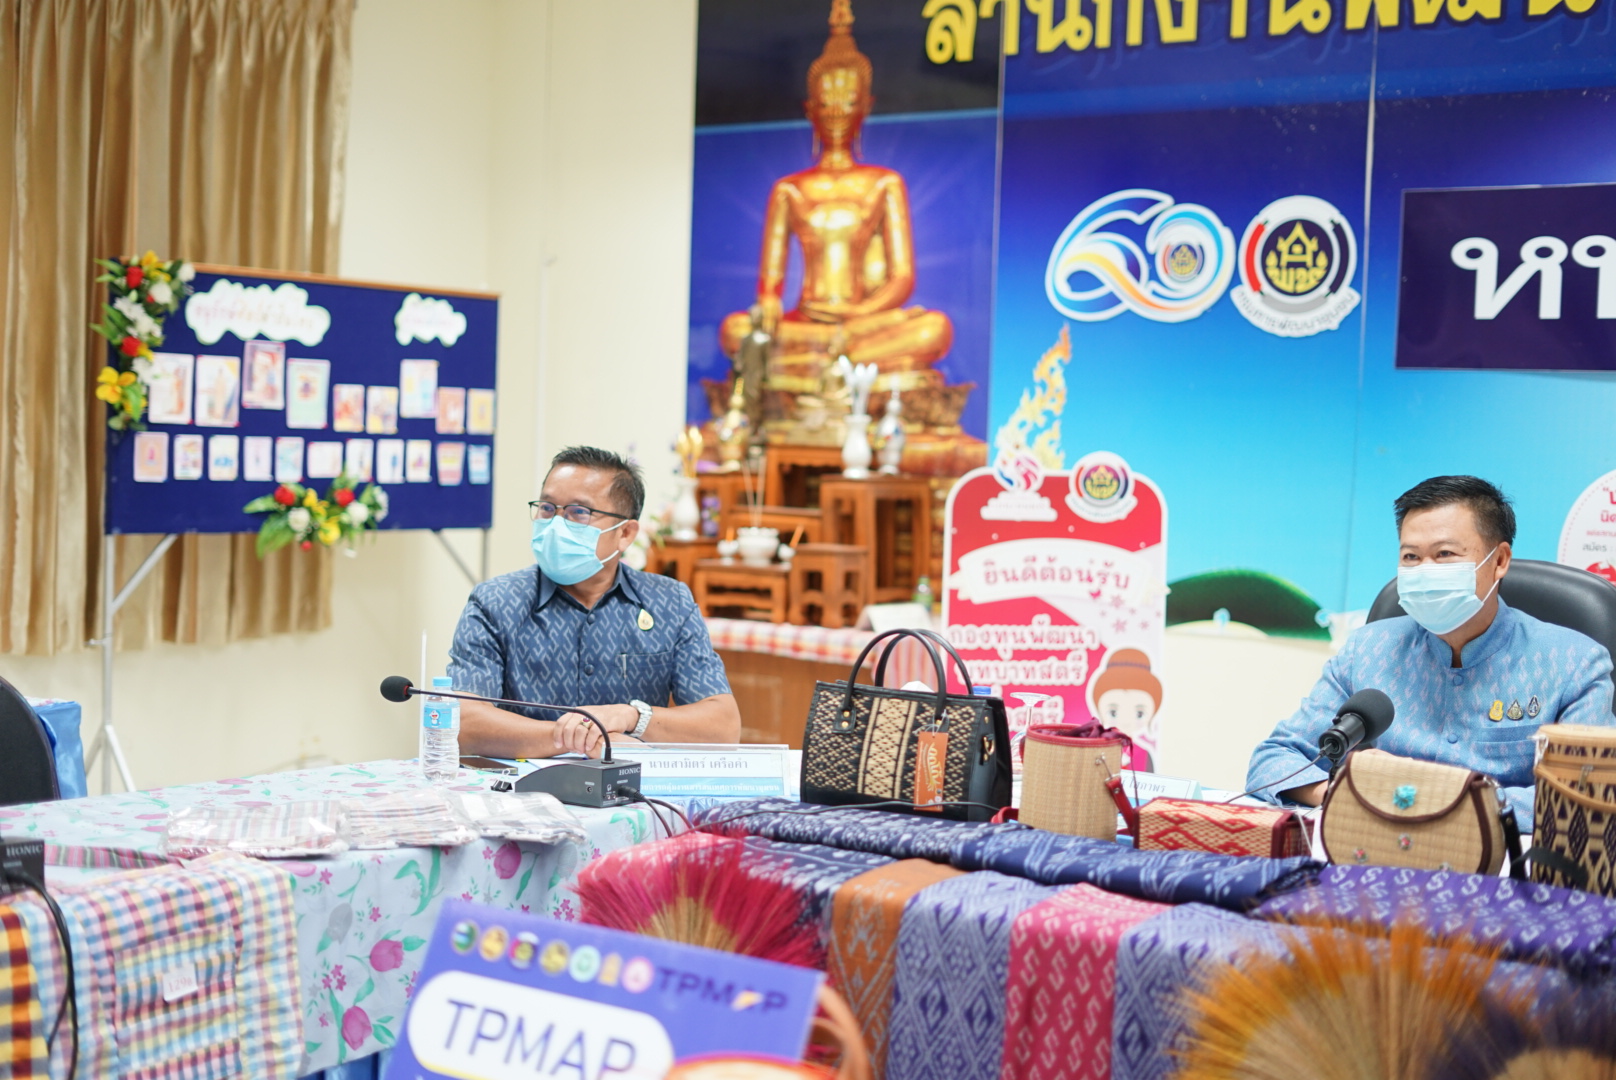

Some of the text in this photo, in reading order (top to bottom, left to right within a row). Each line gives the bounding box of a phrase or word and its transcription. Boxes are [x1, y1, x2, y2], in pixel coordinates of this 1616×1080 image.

[983, 555, 1131, 590] ยินดีต้อนรับ
[950, 619, 1097, 654] กองทุนพัฒนา
[618, 767, 641, 776] HONIC
[443, 998, 637, 1080] TPMAP
